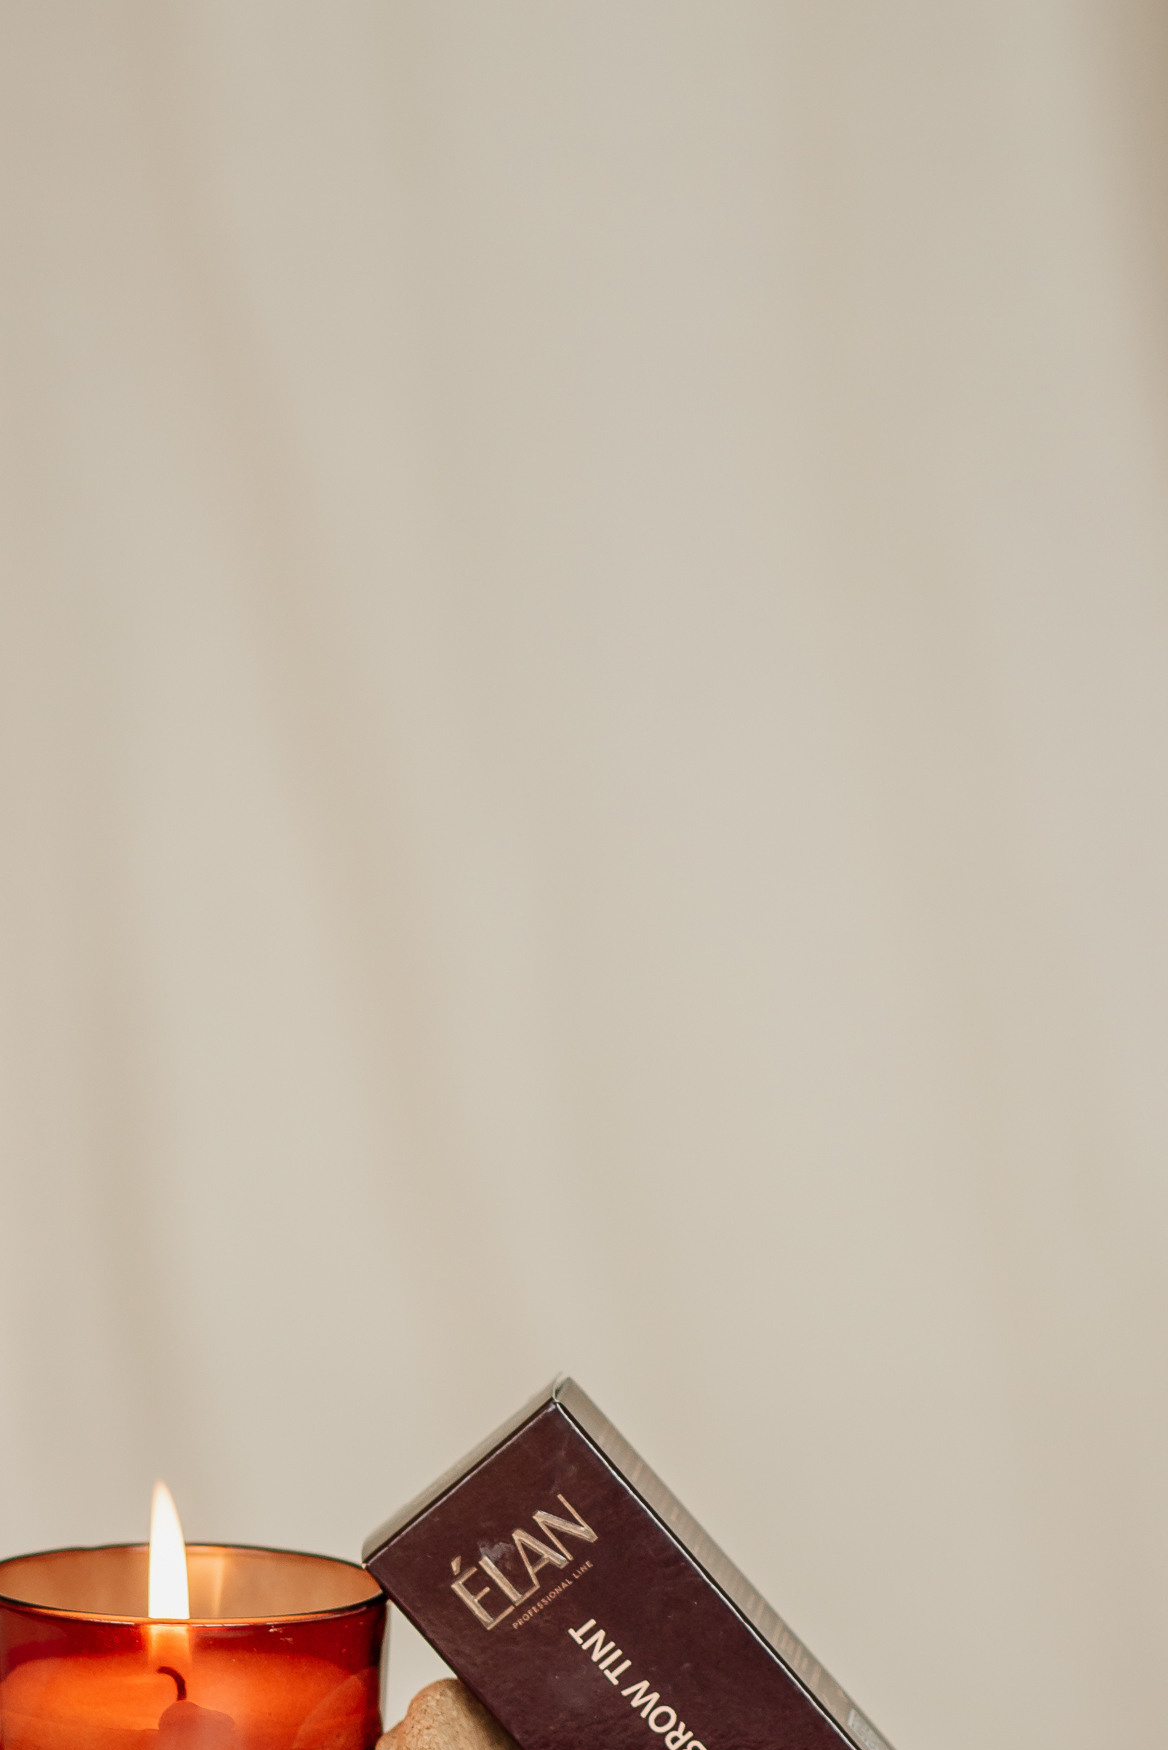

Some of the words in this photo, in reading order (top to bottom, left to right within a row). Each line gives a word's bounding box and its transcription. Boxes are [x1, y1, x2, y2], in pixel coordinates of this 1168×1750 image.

[450, 1493, 599, 1631] ÉLAN
[512, 1578, 573, 1630] PROFESSIONAL
[573, 1560, 594, 1580] LINE
[568, 1618, 632, 1686] TINT
